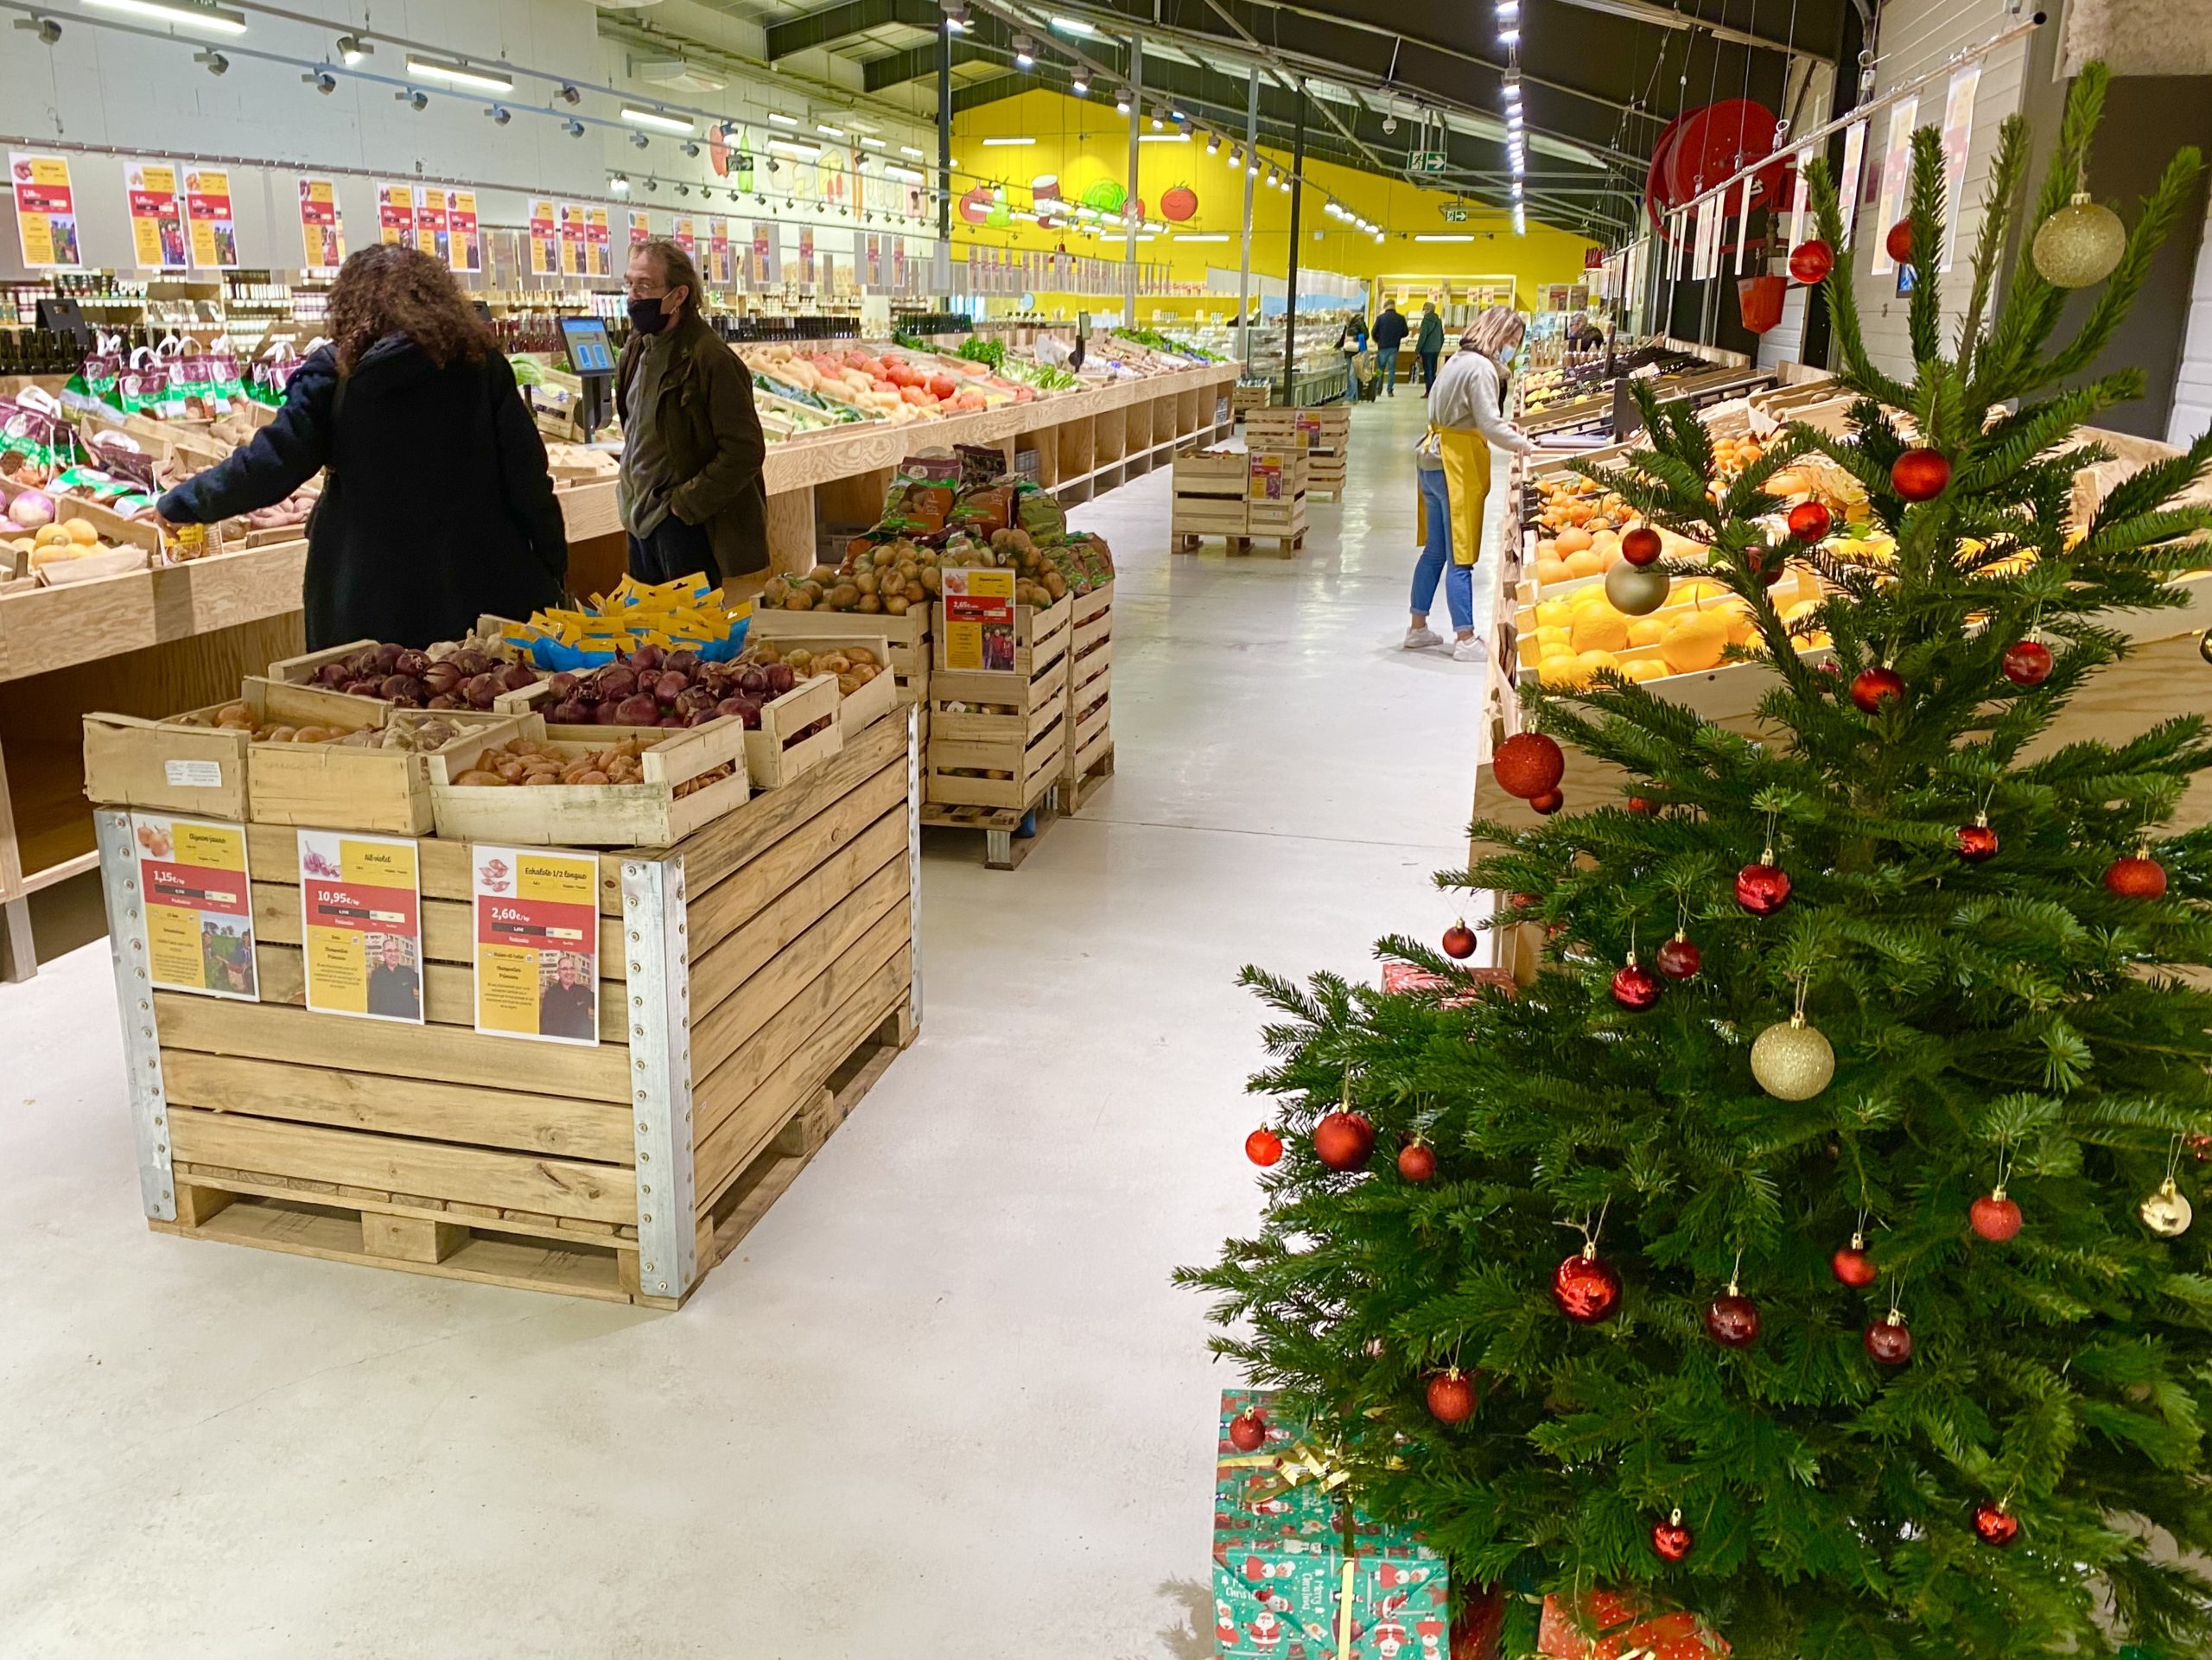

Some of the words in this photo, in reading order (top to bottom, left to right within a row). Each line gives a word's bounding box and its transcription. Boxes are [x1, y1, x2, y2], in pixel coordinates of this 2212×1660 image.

[552, 868, 563, 878] 1/2
[1301, 1573, 1313, 1610] Christmas
[1310, 1580, 1324, 1605] Merry
